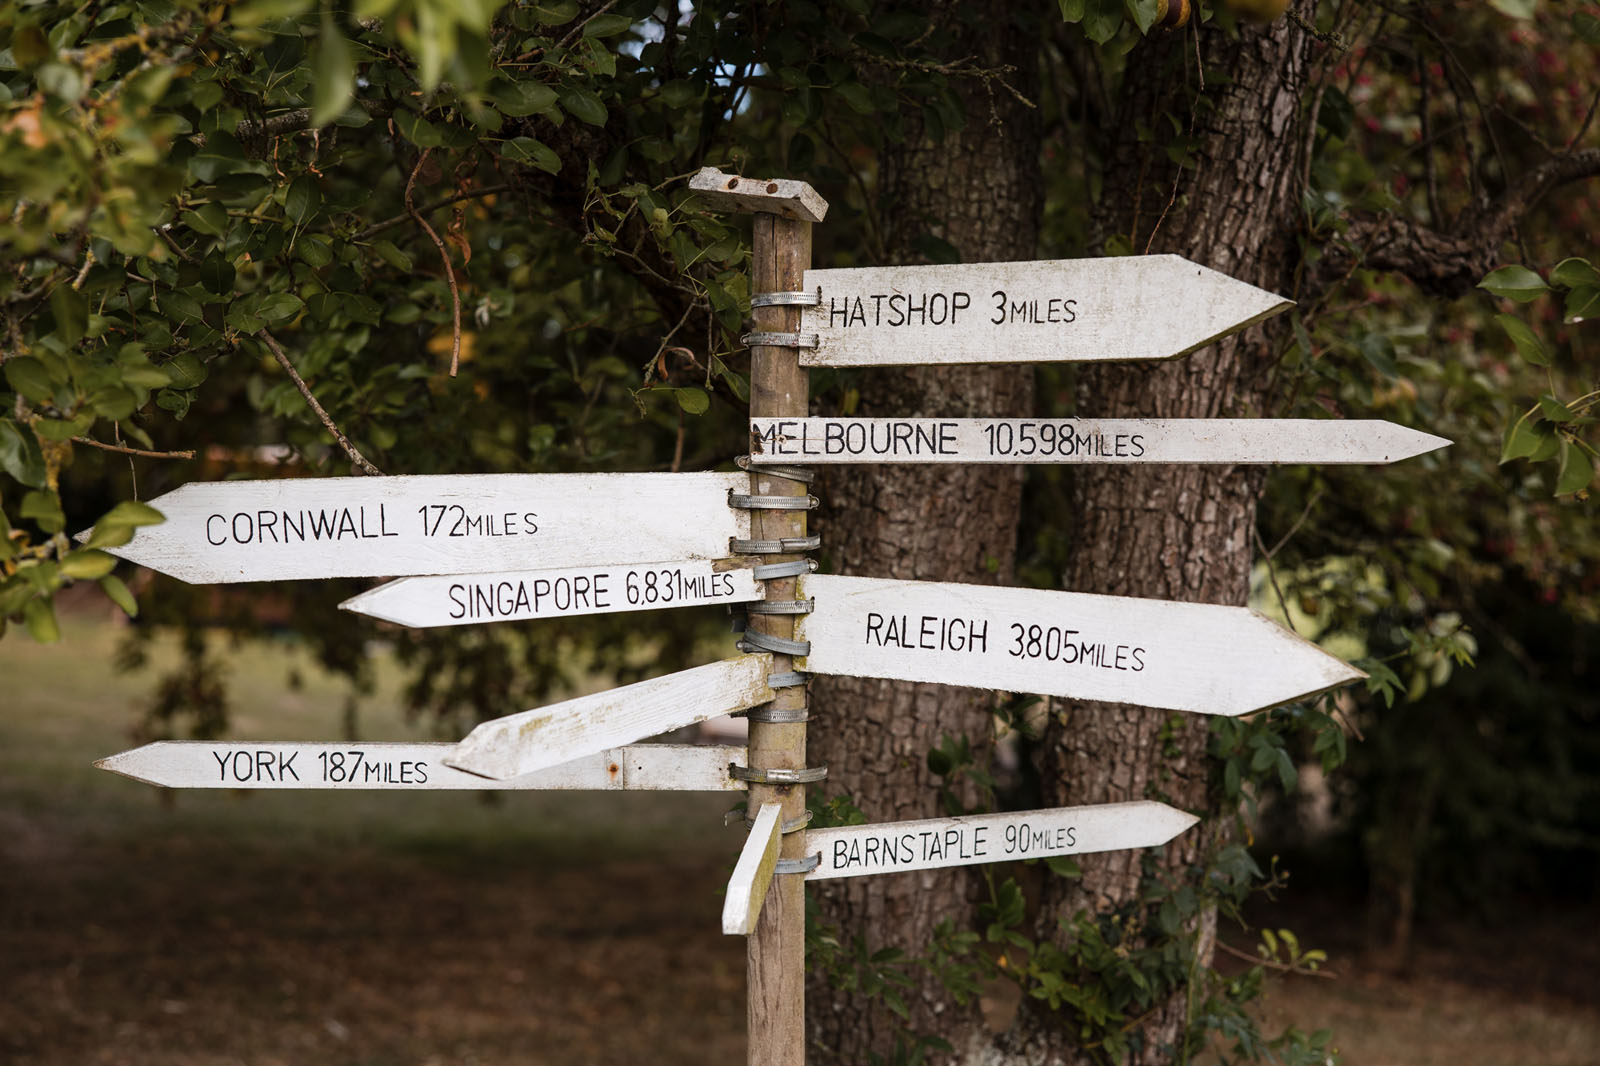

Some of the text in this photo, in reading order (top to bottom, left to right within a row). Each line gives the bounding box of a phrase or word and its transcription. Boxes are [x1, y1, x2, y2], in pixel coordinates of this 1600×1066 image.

[829, 291, 971, 328] HATSHOP
[752, 422, 959, 457] MELBOURNE
[207, 504, 398, 545] CORNWALL
[448, 573, 611, 620] SINGAPORE
[867, 613, 987, 652] RALEIGH
[213, 751, 299, 781] YORK
[831, 826, 989, 869] BARNSTAPLE
